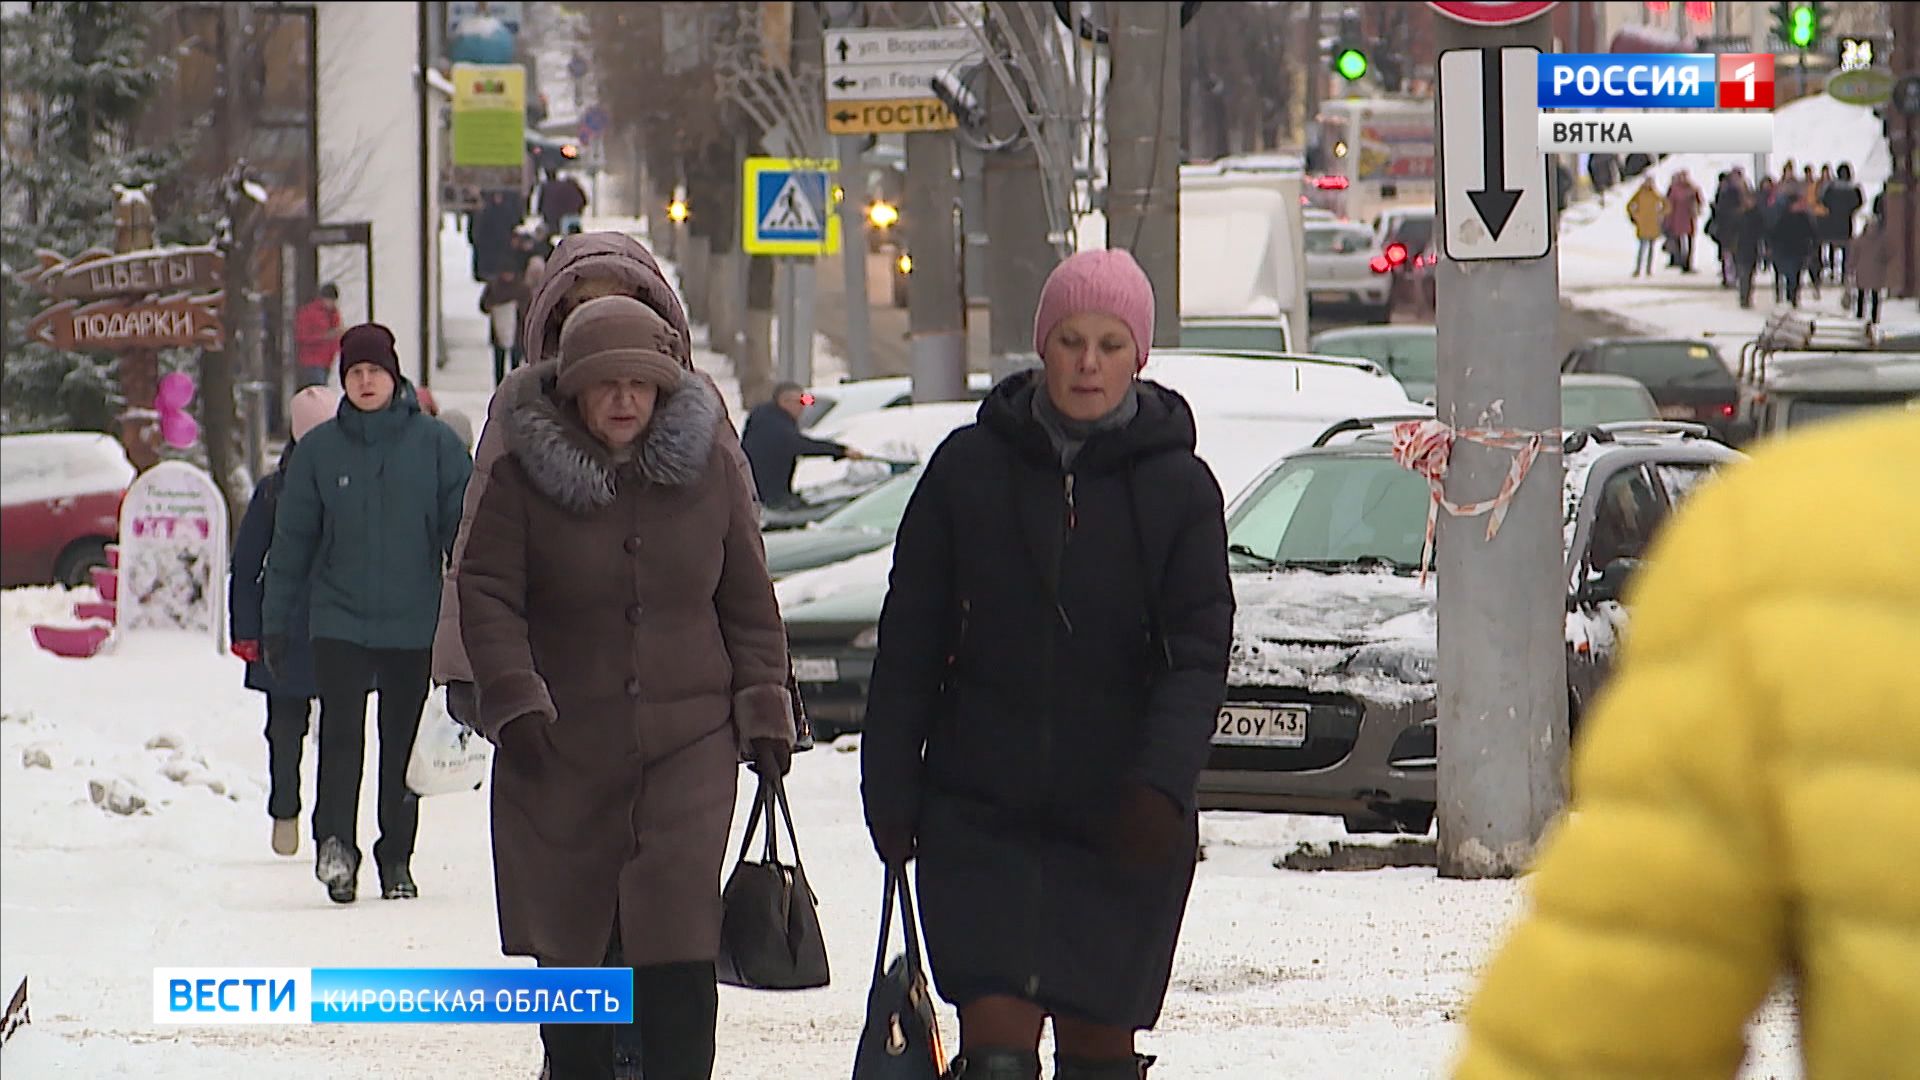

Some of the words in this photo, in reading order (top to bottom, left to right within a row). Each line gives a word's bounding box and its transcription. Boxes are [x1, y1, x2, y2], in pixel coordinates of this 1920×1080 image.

[90, 256, 195, 292] ЦВЕТЫ
[74, 310, 193, 340] ПОДАРКИ
[1220, 711, 1266, 736] 2ОУ
[1274, 712, 1298, 731] 43
